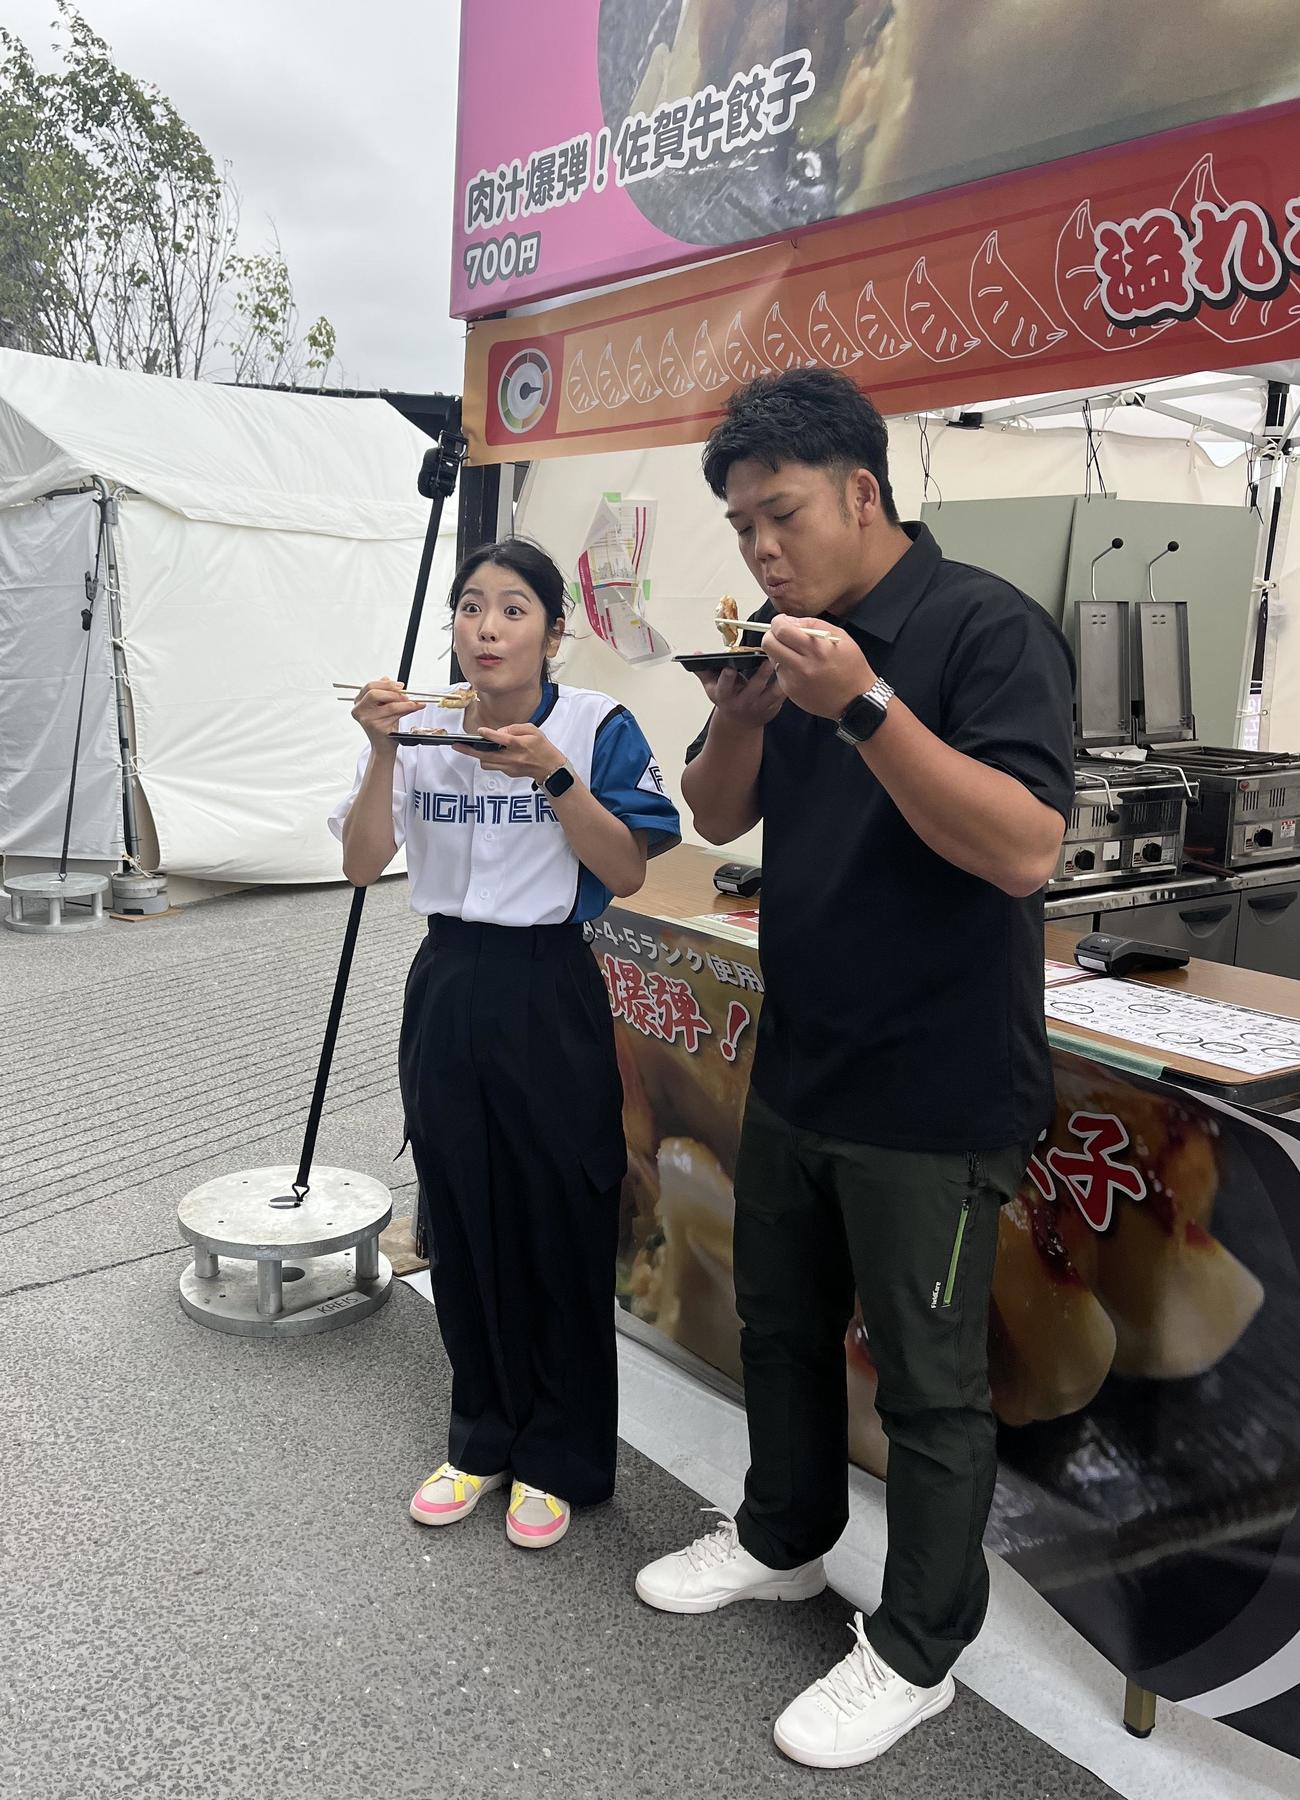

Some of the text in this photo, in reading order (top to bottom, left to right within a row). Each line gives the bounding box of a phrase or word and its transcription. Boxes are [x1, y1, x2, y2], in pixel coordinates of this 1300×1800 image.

[465, 50, 814, 232] 肉汁爆弾！佐賀牛餃子
[464, 231, 541, 288] 700円
[1094, 199, 1300, 321] 溢れ
[1026, 1110, 1147, 1232] 子
